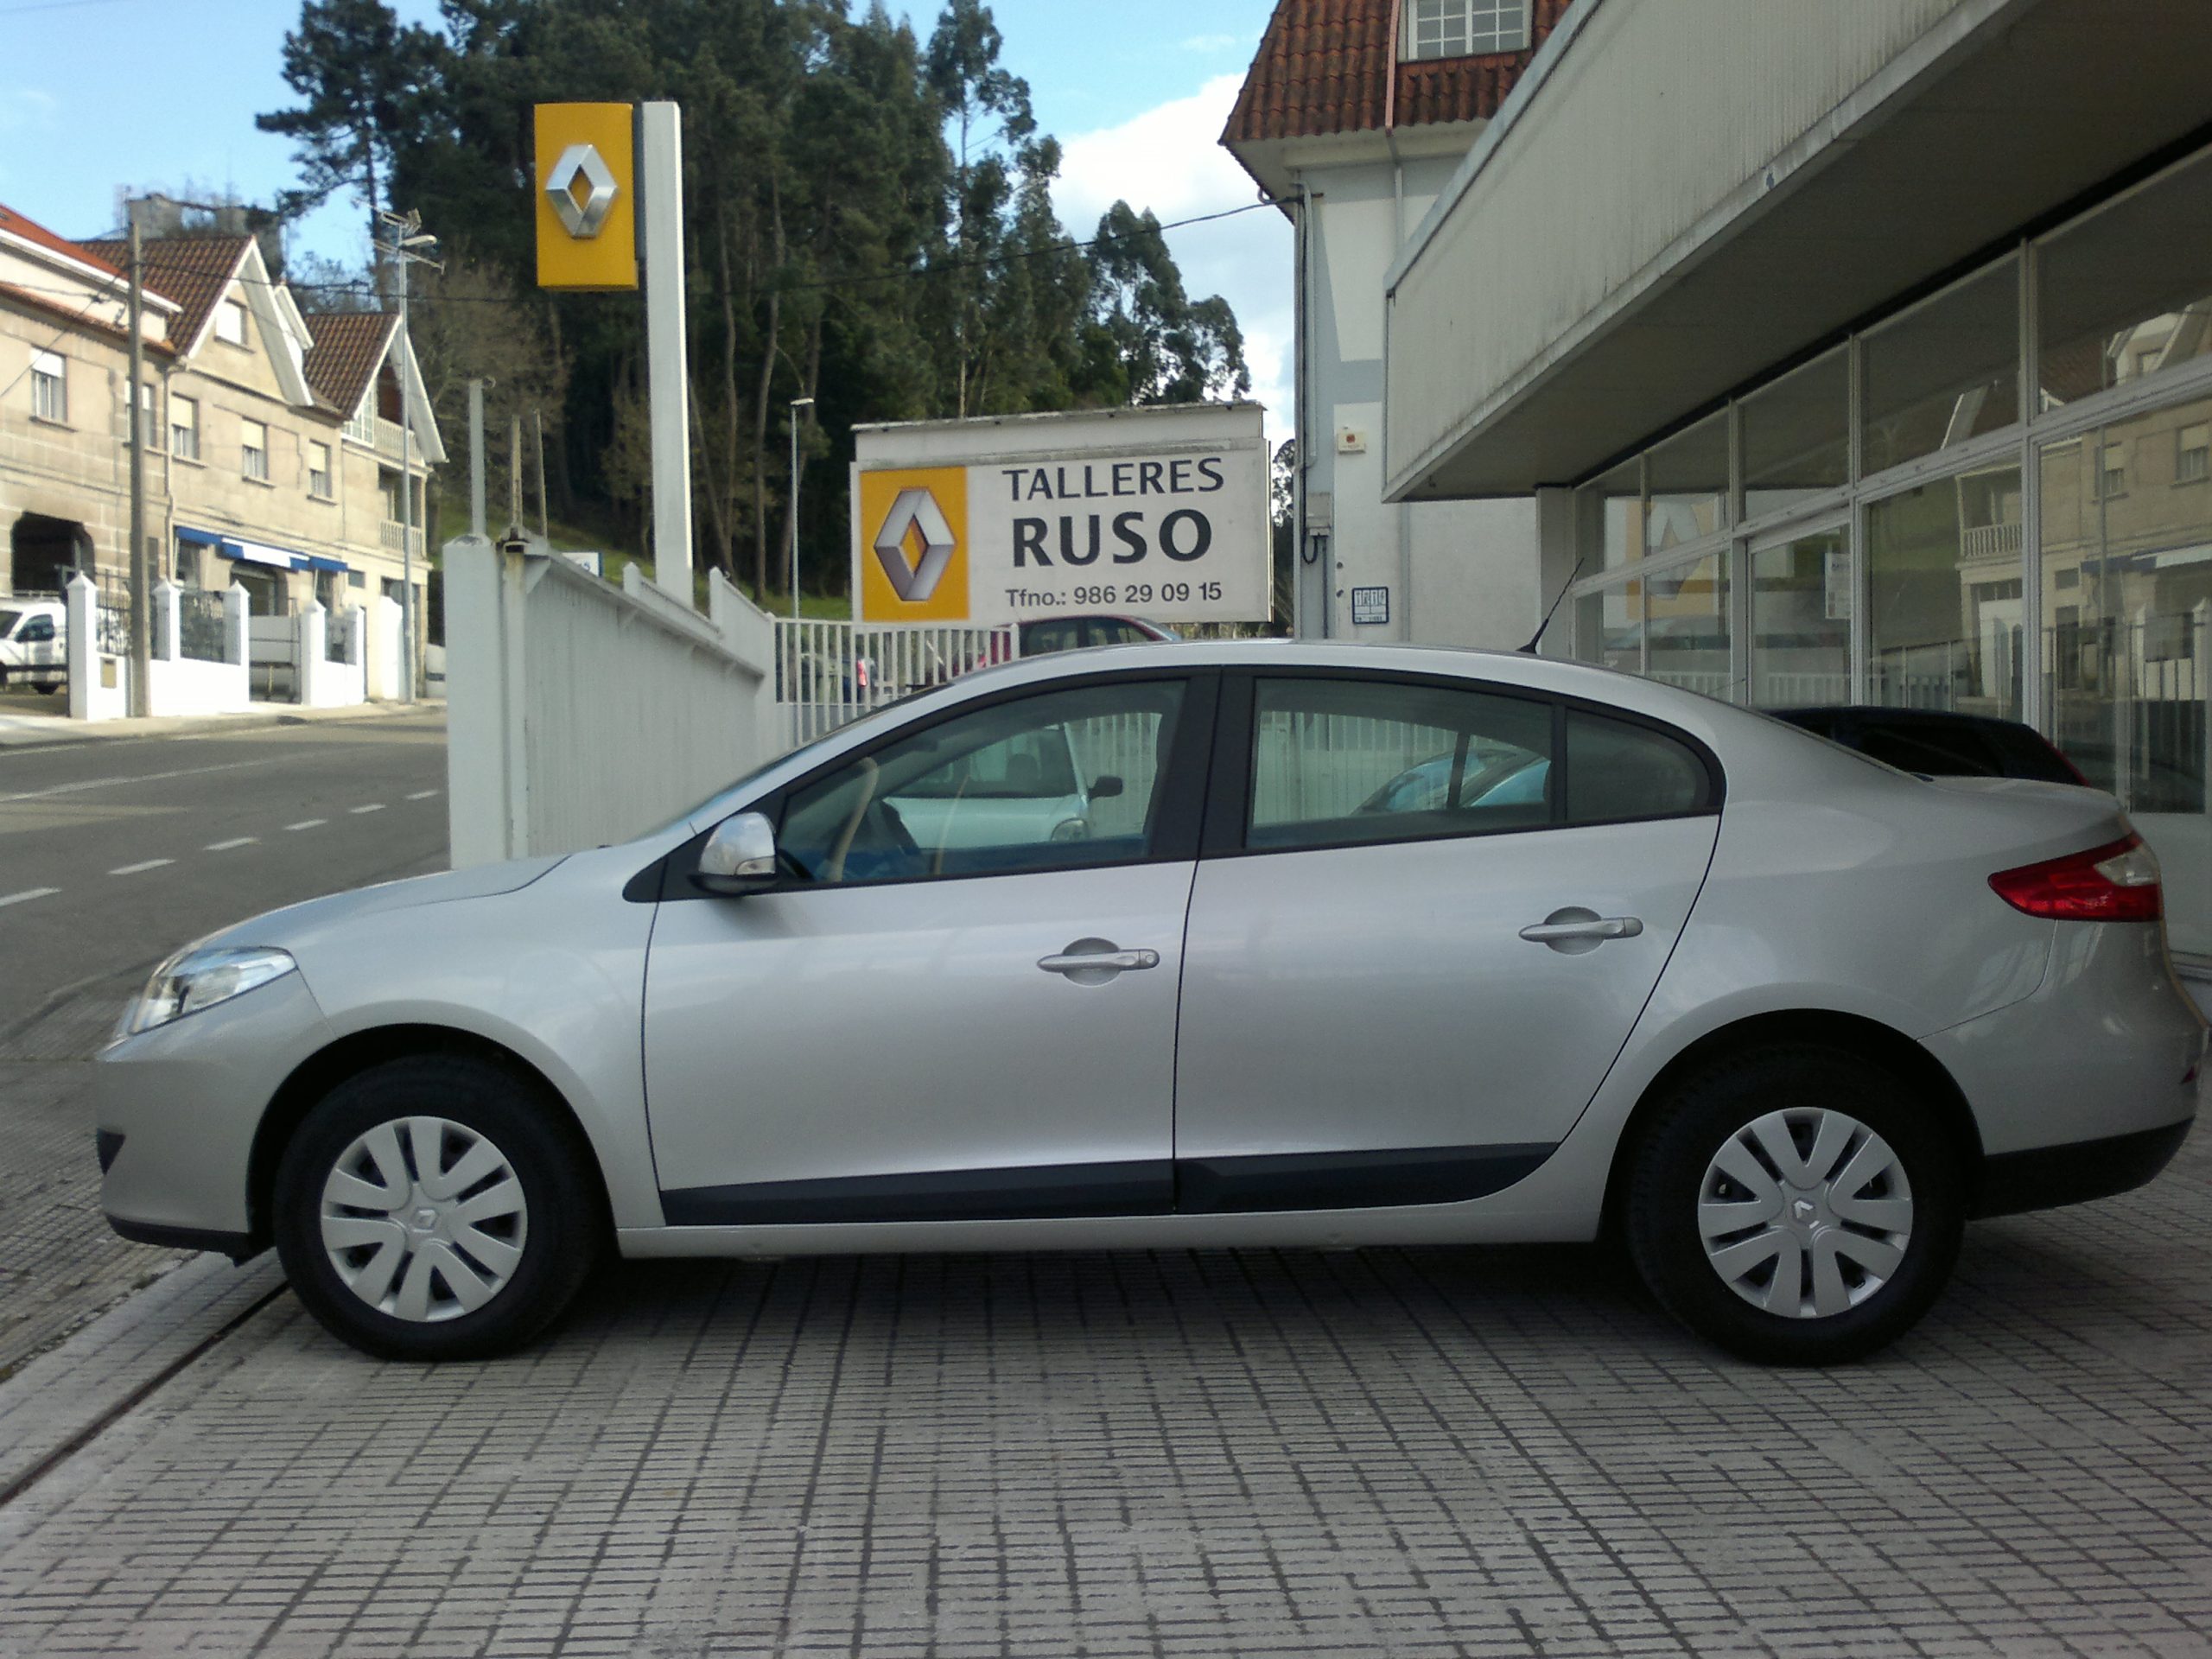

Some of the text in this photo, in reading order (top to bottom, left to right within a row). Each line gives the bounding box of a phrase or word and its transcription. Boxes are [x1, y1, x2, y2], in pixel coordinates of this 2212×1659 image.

[1001, 457, 1224, 501] TALLERES
[1013, 508, 1212, 568] RUSO
[1005, 582, 1222, 607] Tfno.: 986 29 09 15
